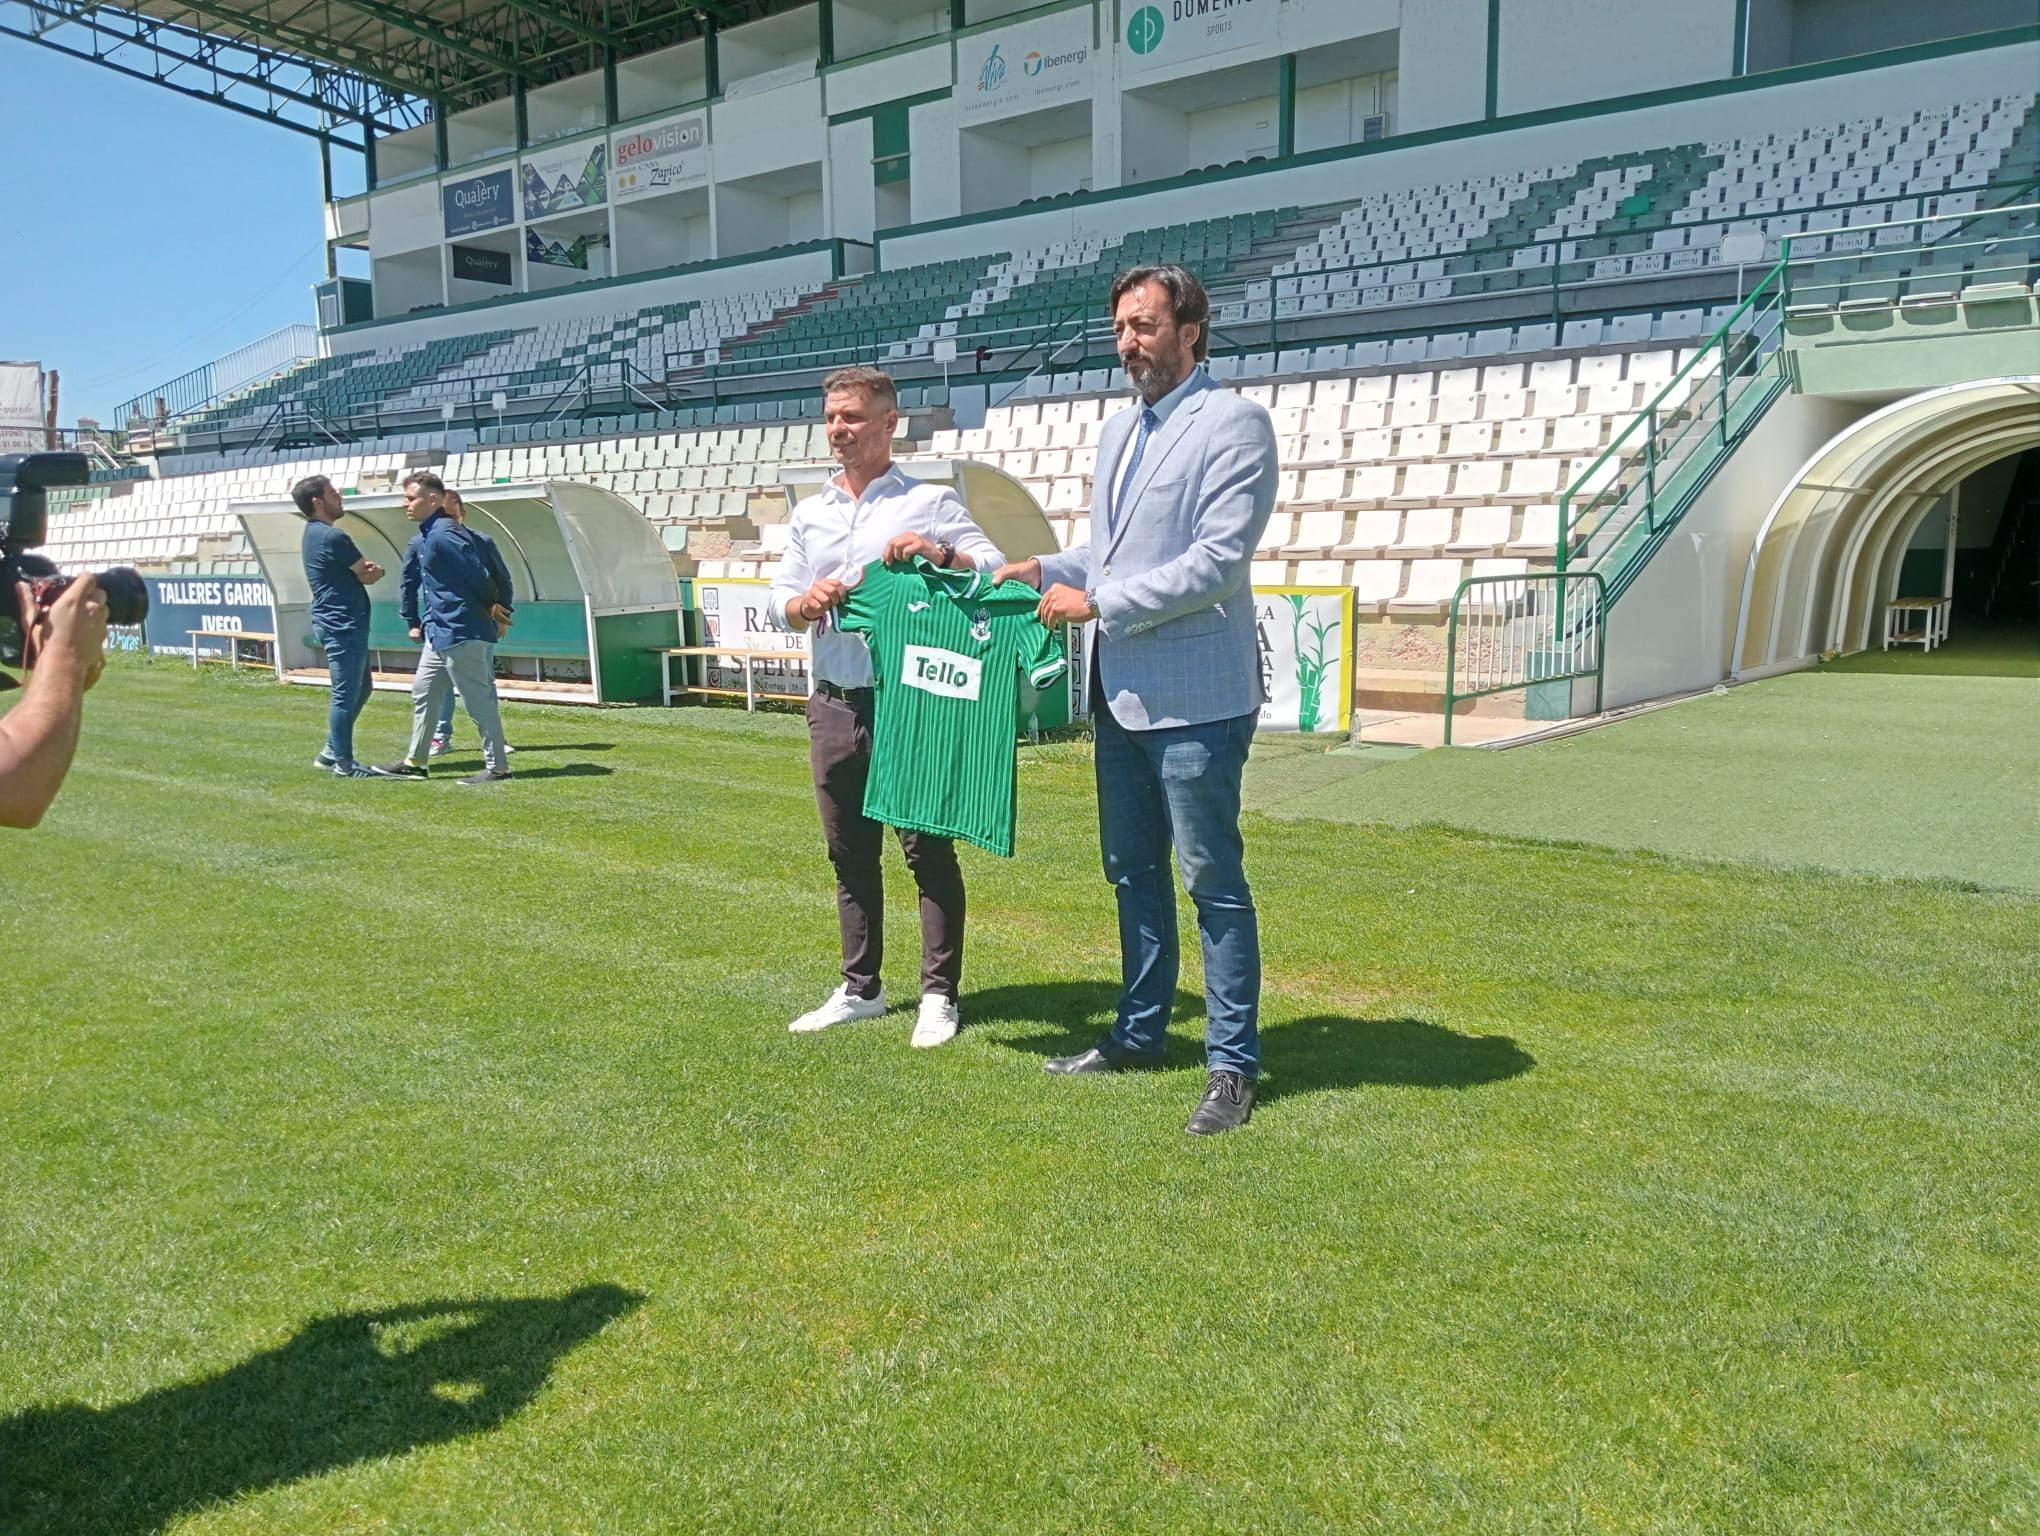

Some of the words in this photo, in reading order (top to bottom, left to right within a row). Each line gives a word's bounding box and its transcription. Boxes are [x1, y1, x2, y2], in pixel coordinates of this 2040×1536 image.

[1206, 20, 1233, 37] SPORTS
[1044, 46, 1088, 69] Ibenergi
[617, 125, 700, 165] gelovision
[649, 163, 683, 186] Zapico
[455, 184, 500, 208] Qualery
[465, 255, 499, 269] Qualery
[158, 582, 222, 605] TALLERES
[202, 615, 241, 632] IVECO
[785, 635, 804, 650] DE
[916, 656, 968, 688] Tello
